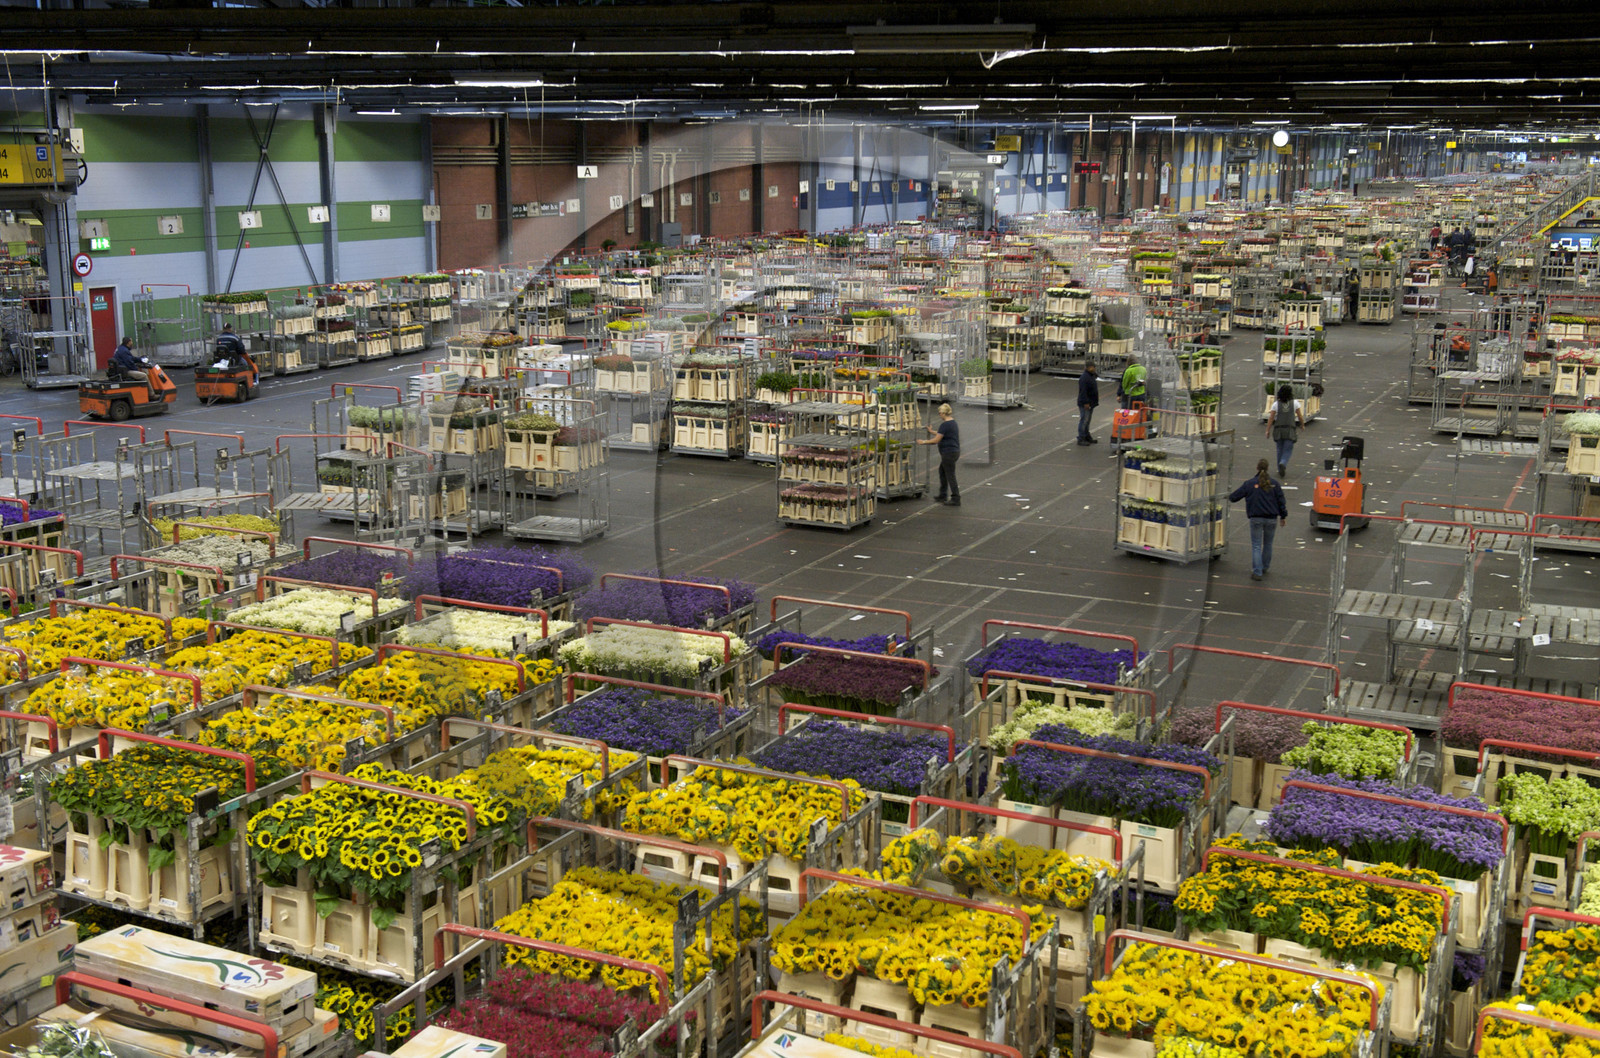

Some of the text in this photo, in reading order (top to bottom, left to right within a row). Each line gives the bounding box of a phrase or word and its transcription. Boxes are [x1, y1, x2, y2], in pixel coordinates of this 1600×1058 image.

[35, 167, 53, 179] 004
[583, 167, 592, 177] A
[612, 197, 620, 208] 10
[379, 209, 384, 217] 5
[481, 206, 487, 218] 7
[246, 218, 252, 226] 3
[316, 213, 321, 222] 4
[93, 227, 97, 236] 1
[168, 224, 174, 234] 2
[1331, 478, 1341, 488] K
[1324, 489, 1343, 498] 139
